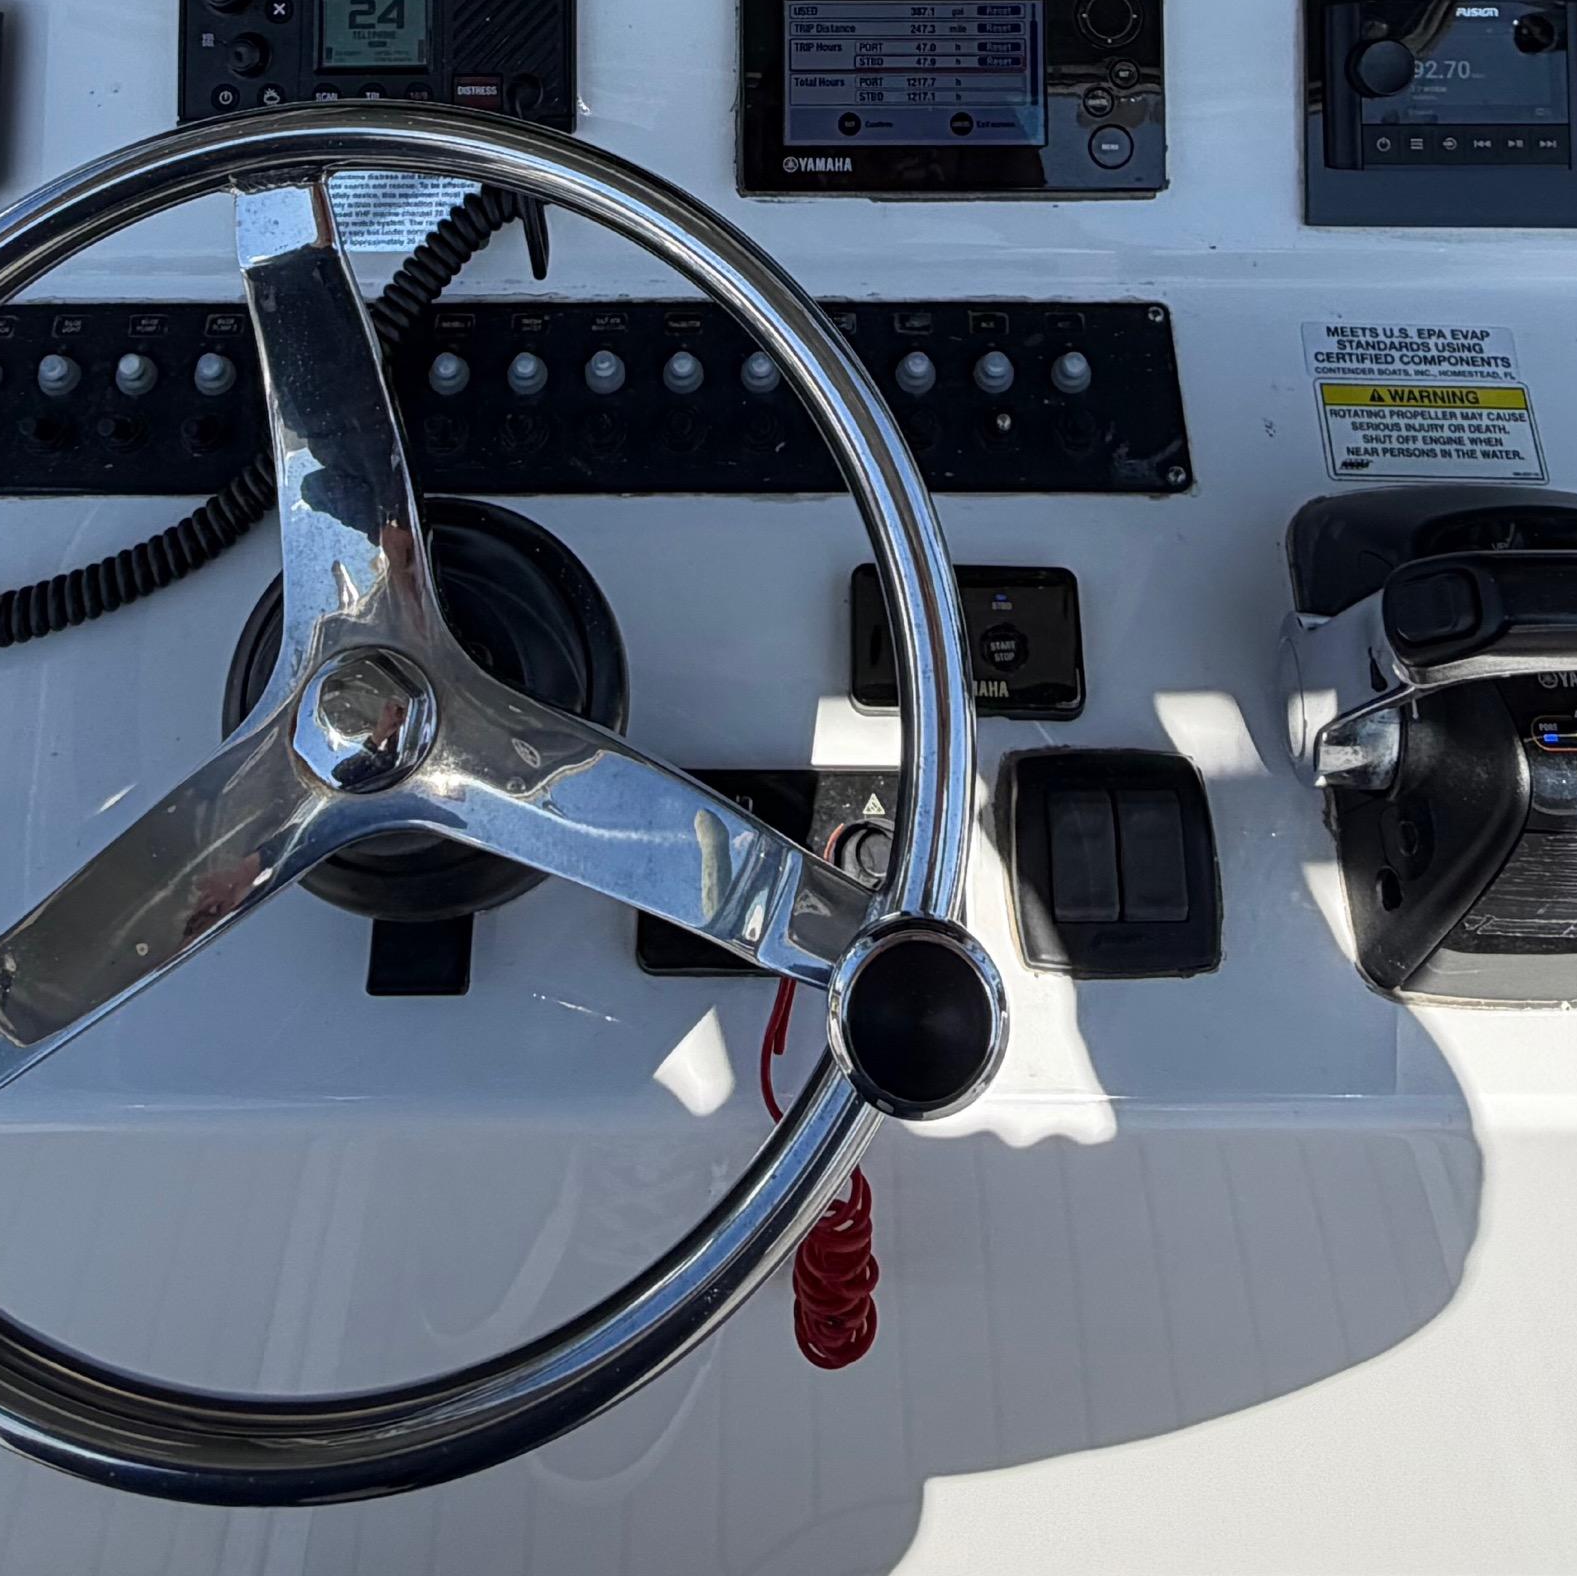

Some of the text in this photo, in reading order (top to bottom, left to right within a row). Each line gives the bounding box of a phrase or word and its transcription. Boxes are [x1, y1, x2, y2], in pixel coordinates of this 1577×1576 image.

[815, 23, 856, 34] Distance
[858, 42, 884, 53] PORT
[793, 77, 817, 88] Total
[858, 77, 884, 88] PORT
[456, 85, 498, 97] DISTRESS
[798, 157, 853, 174] YAMAHA
[400, 173, 415, 181] and
[372, 182, 388, 190] and
[418, 181, 429, 189] To
[430, 181, 440, 189] be
[398, 191, 440, 200] equipment
[409, 219, 424, 227] The
[1326, 325, 1491, 341] MEETS U.S. EPA EVAP
[1336, 339, 1485, 354] STANDARDS USING
[1313, 351, 1512, 369] CERTIFIED COMPONENTS
[1313, 366, 1375, 376] CONTENDER
[1387, 388, 1480, 405] WARNING
[1329, 408, 1527, 423] ROTATING PROPELLER MAY CAUSE
[1351, 421, 1510, 435] SERIOUS INJURY OR DEATH.
[1362, 434, 1504, 447] SHUT OFF ENGINE WHEN
[1346, 446, 1525, 461] NEAR PERSONS IN THE WATER.
[989, 640, 1017, 652] START
[993, 651, 1016, 663] STOP
